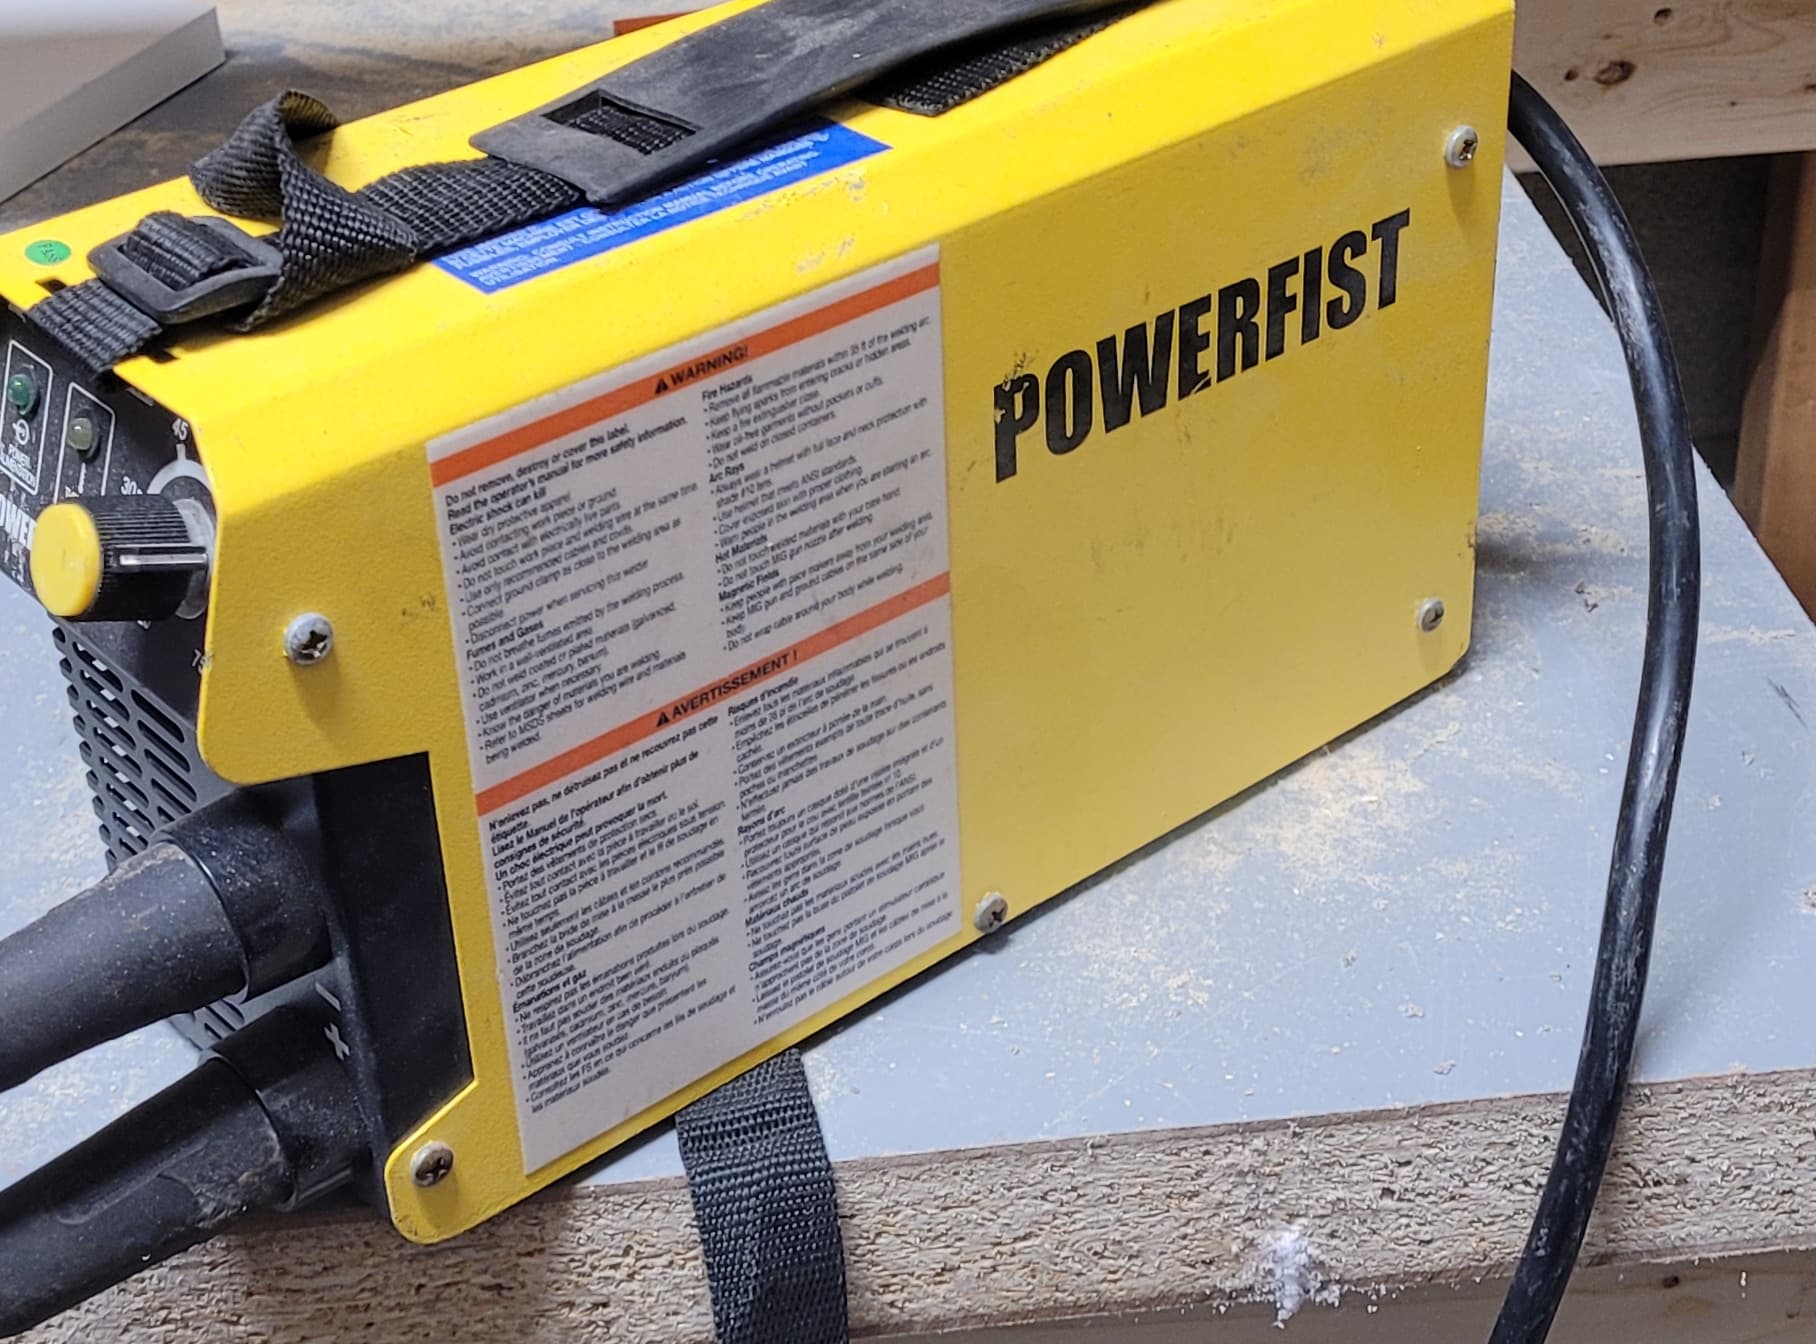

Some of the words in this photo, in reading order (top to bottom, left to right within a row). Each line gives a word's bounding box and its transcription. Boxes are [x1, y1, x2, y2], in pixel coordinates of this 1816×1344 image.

[669, 343, 748, 387] WARNING!
[993, 208, 1411, 484] POWERFIST
[171, 418, 189, 441] 45
[671, 652, 789, 719] AVERTISSEMENT
